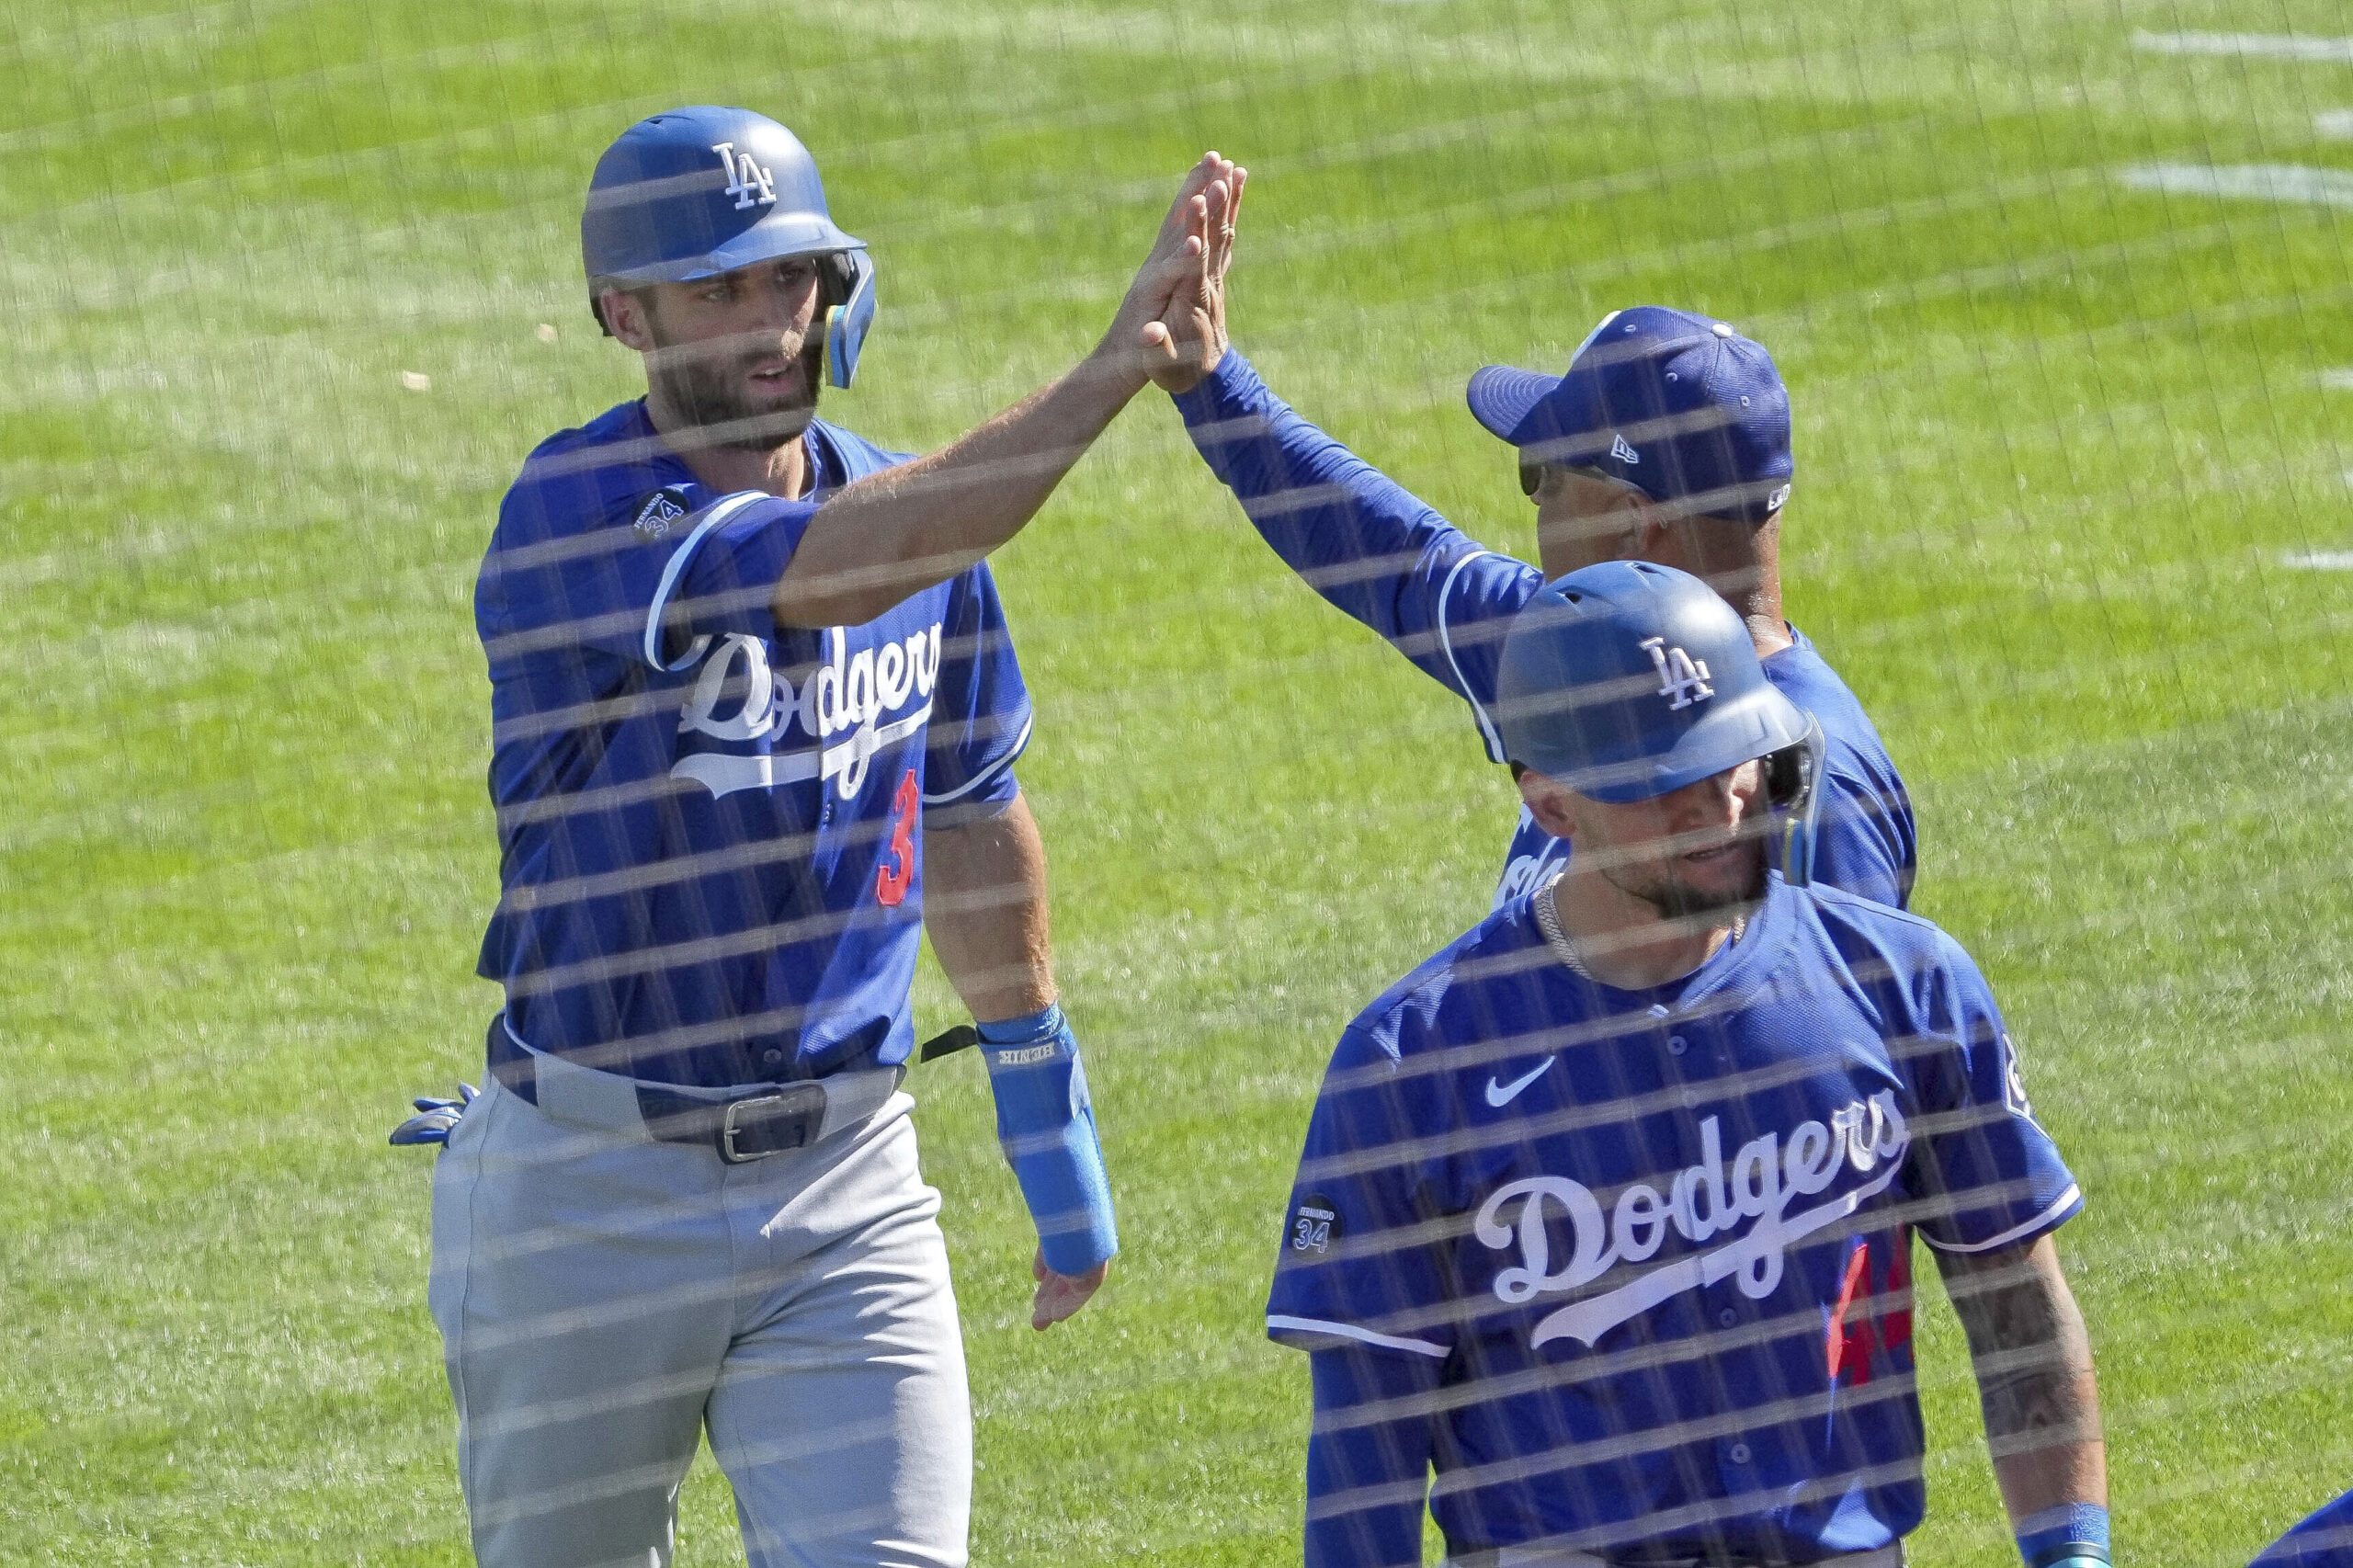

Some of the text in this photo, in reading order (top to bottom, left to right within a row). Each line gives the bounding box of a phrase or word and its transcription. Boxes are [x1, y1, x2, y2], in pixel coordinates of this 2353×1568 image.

[712, 142, 777, 210] LA
[645, 500, 684, 538] 34
[1639, 636, 1714, 710] LA
[1294, 1219, 1330, 1253] 34
[1472, 1086, 1912, 1324] Dodgers
